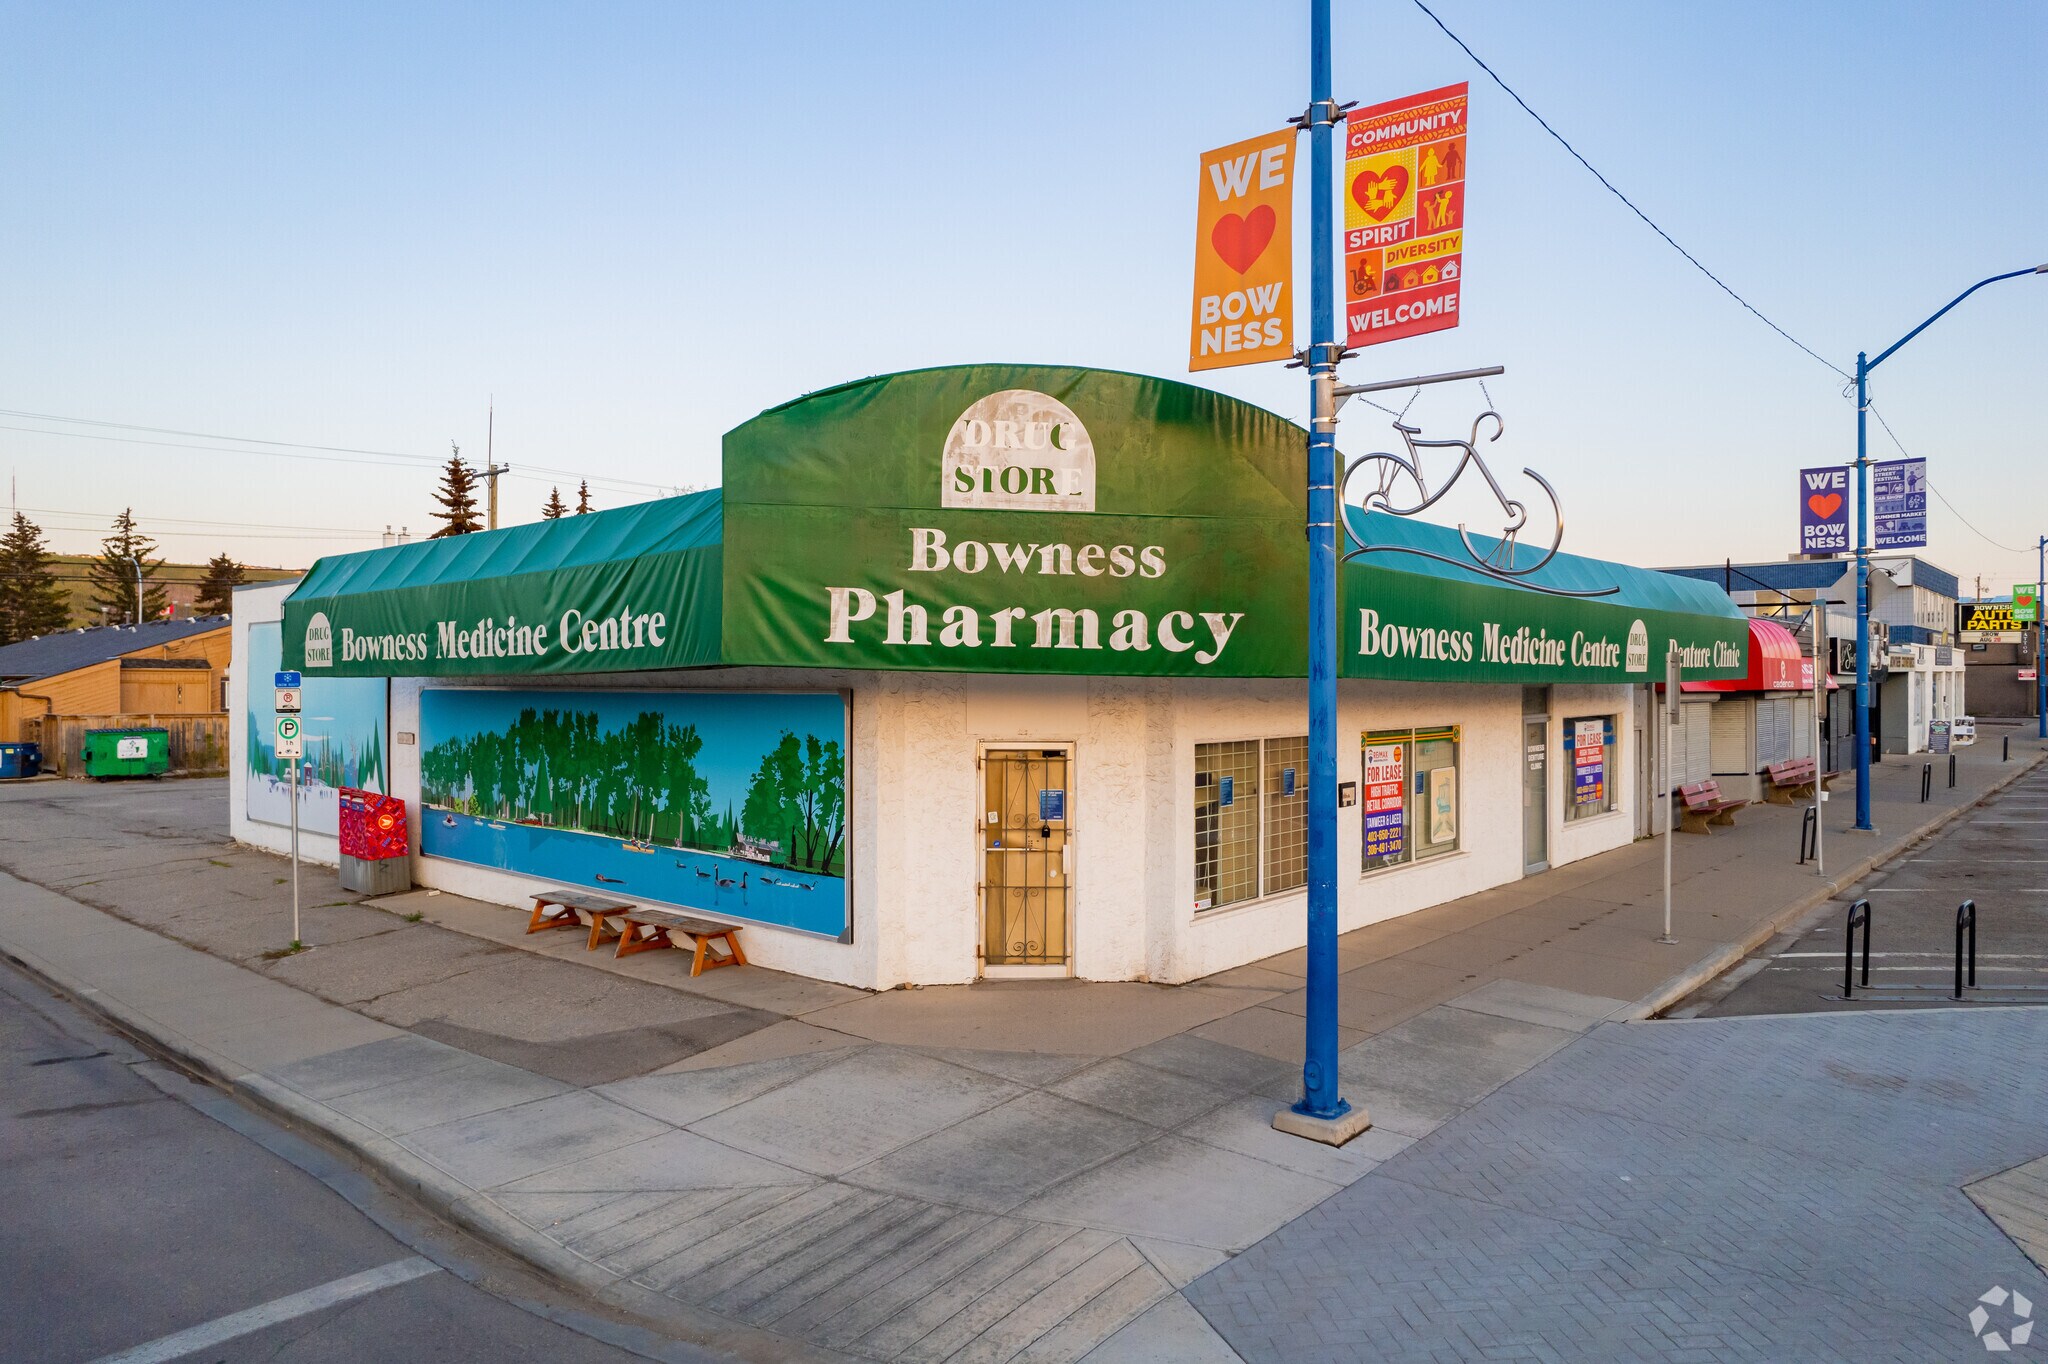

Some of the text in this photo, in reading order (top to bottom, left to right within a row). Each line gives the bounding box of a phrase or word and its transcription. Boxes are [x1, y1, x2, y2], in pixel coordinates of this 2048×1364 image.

[1351, 109, 1462, 147] COMMUNITY
[1209, 144, 1287, 202] WE
[1349, 221, 1410, 248] SPIRIT
[1387, 236, 1460, 264] DIVERSITY
[1200, 282, 1283, 325] BOW
[1350, 293, 1457, 333] WELCOME
[1200, 317, 1283, 356] NESS
[964, 420, 1077, 451] DRUG
[954, 465, 1083, 496] STORE
[1805, 471, 1846, 490] WE
[1874, 470, 1896, 478] STREET
[1804, 523, 1845, 537] BOW
[1805, 536, 1846, 549] NESS
[1876, 534, 1926, 545] WELCOME
[908, 527, 1166, 579] Bowness
[2015, 586, 2034, 594] WE
[1971, 610, 2013, 620] AUTO
[341, 604, 666, 662] Bowness Medicine Centre
[824, 586, 1245, 665] Pharmacy
[1967, 620, 2022, 630] PARTS
[308, 626, 329, 642] DRUG
[1358, 608, 1620, 667] Bowness Medicine Centre
[1629, 633, 1646, 646] DRUG
[307, 648, 331, 662] STORE
[1628, 653, 1646, 666] STORE
[1713, 640, 1740, 668] Clinic
[1773, 679, 1794, 688] cadence
[284, 722, 295, 735] P
[1577, 733, 1602, 747] FOR LEASE
[1528, 744, 1544, 753] BOWNESS
[1367, 765, 1402, 782] FOR LEASE
[1371, 784, 1398, 798] HIGH TRAFFIC
[1367, 796, 1402, 812] RETAIL CORRIDOR
